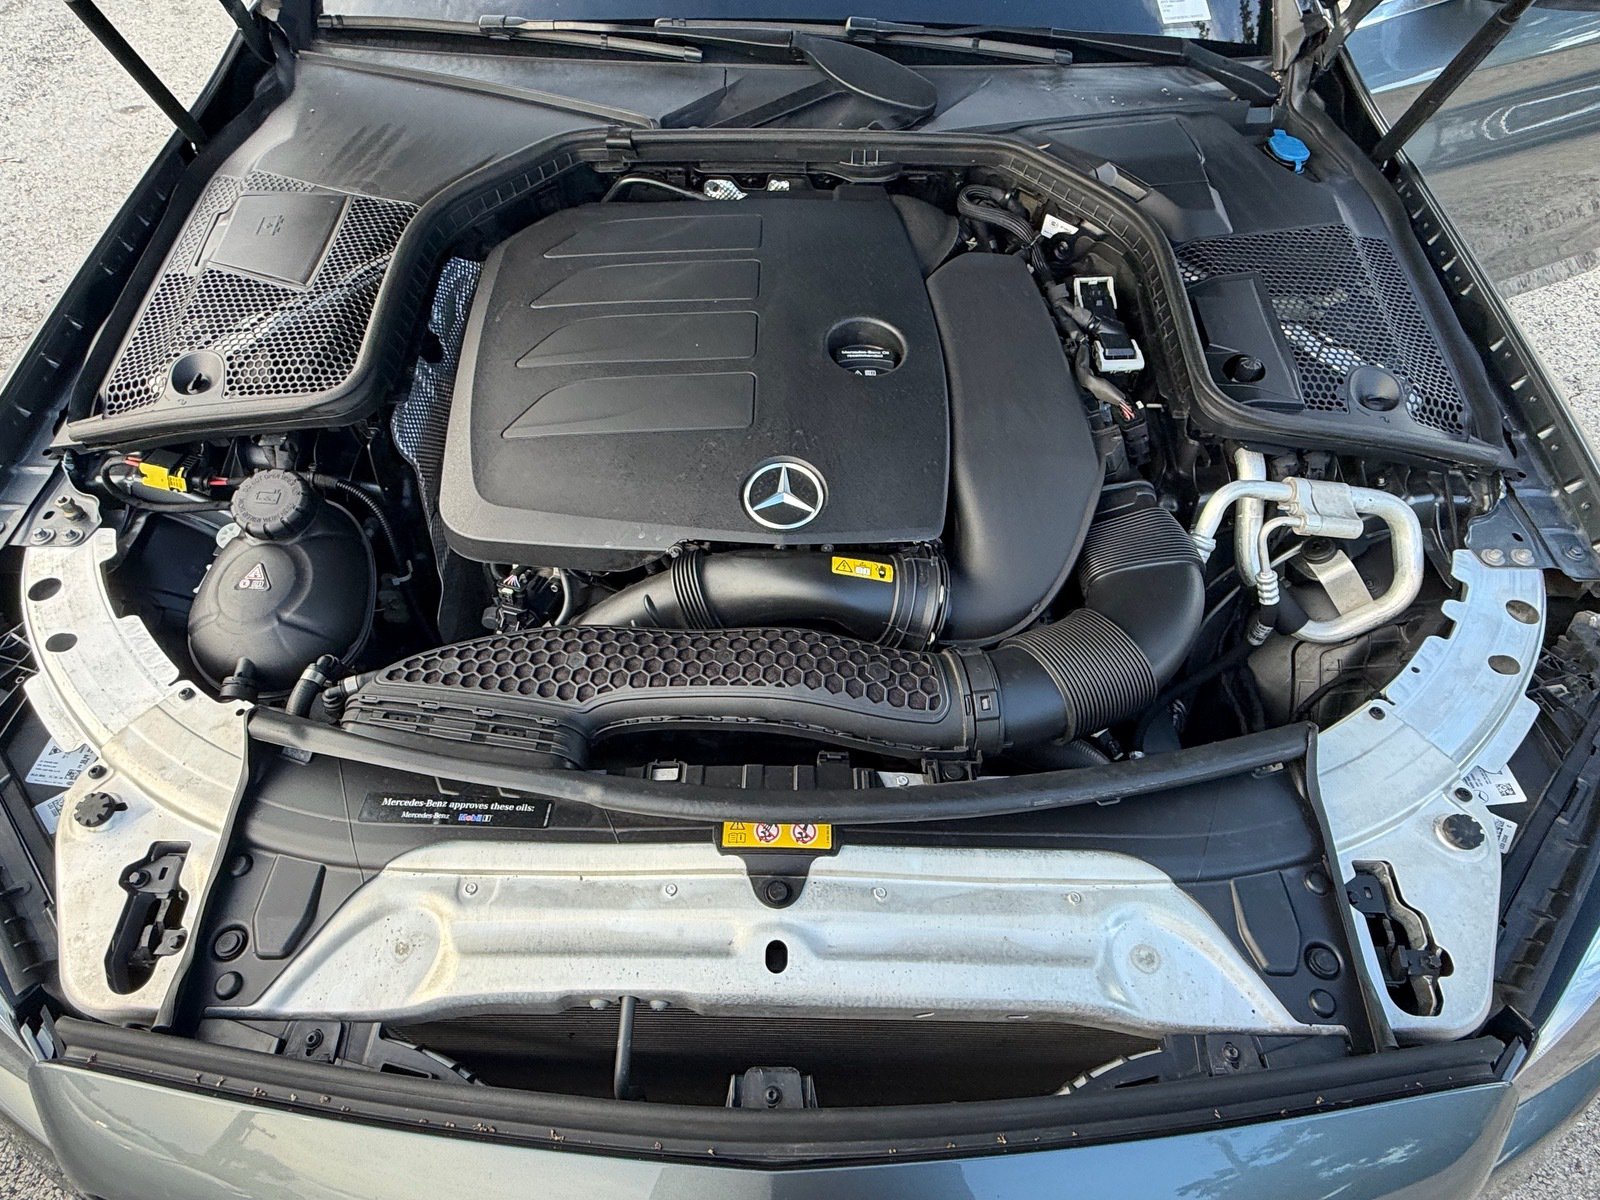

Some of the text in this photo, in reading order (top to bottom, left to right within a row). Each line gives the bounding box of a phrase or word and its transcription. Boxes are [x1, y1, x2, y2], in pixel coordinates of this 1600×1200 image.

[381, 797, 535, 812] Mercedes-Benz approves these oils:
[401, 811, 450, 819] Mercedes-Benz
[458, 813, 482, 822] Mobil
